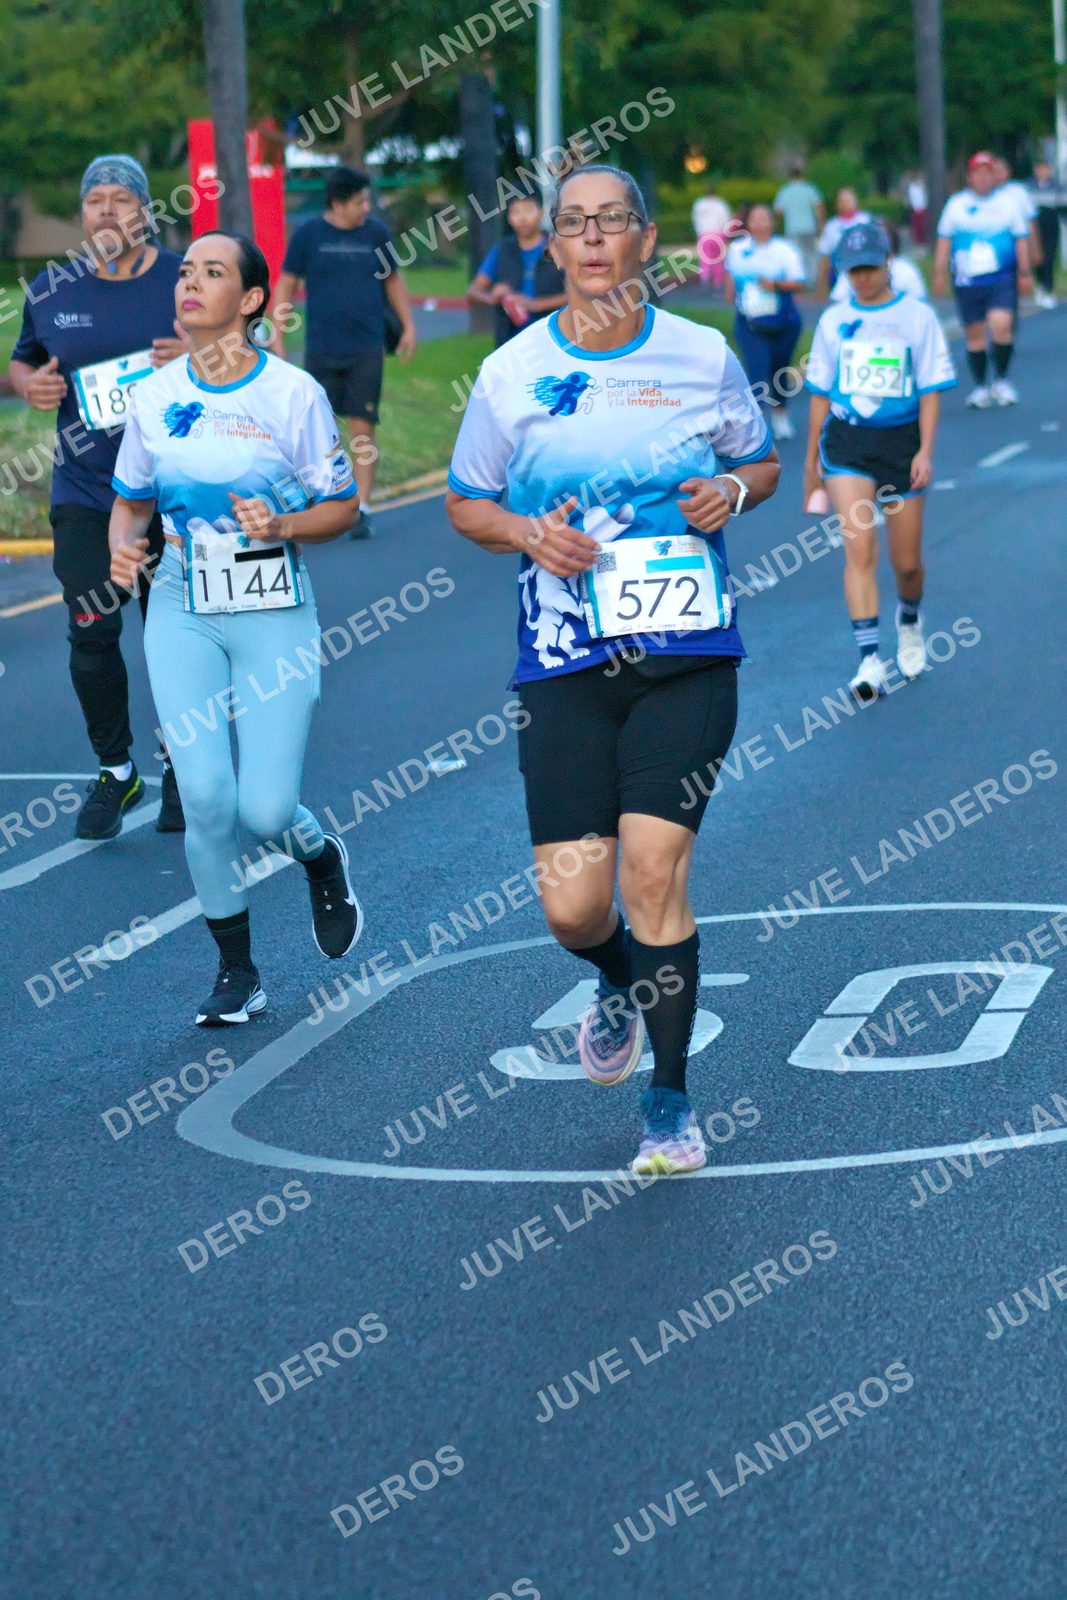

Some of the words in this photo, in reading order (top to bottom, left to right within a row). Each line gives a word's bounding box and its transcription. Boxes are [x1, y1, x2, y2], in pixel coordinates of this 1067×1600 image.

[605, 378, 661, 388] Carrera
[845, 366, 901, 390] 1952
[607, 390, 623, 399] por
[627, 388, 637, 397] la
[639, 388, 662, 397] Vida
[607, 400, 613, 408] y
[615, 399, 625, 407] la
[627, 398, 682, 409] Integridad
[213, 410, 254, 423] Carrera
[236, 422, 257, 432] Vida
[227, 428, 272, 440] Integridad
[198, 561, 292, 602] 1144
[616, 576, 702, 621] 572
